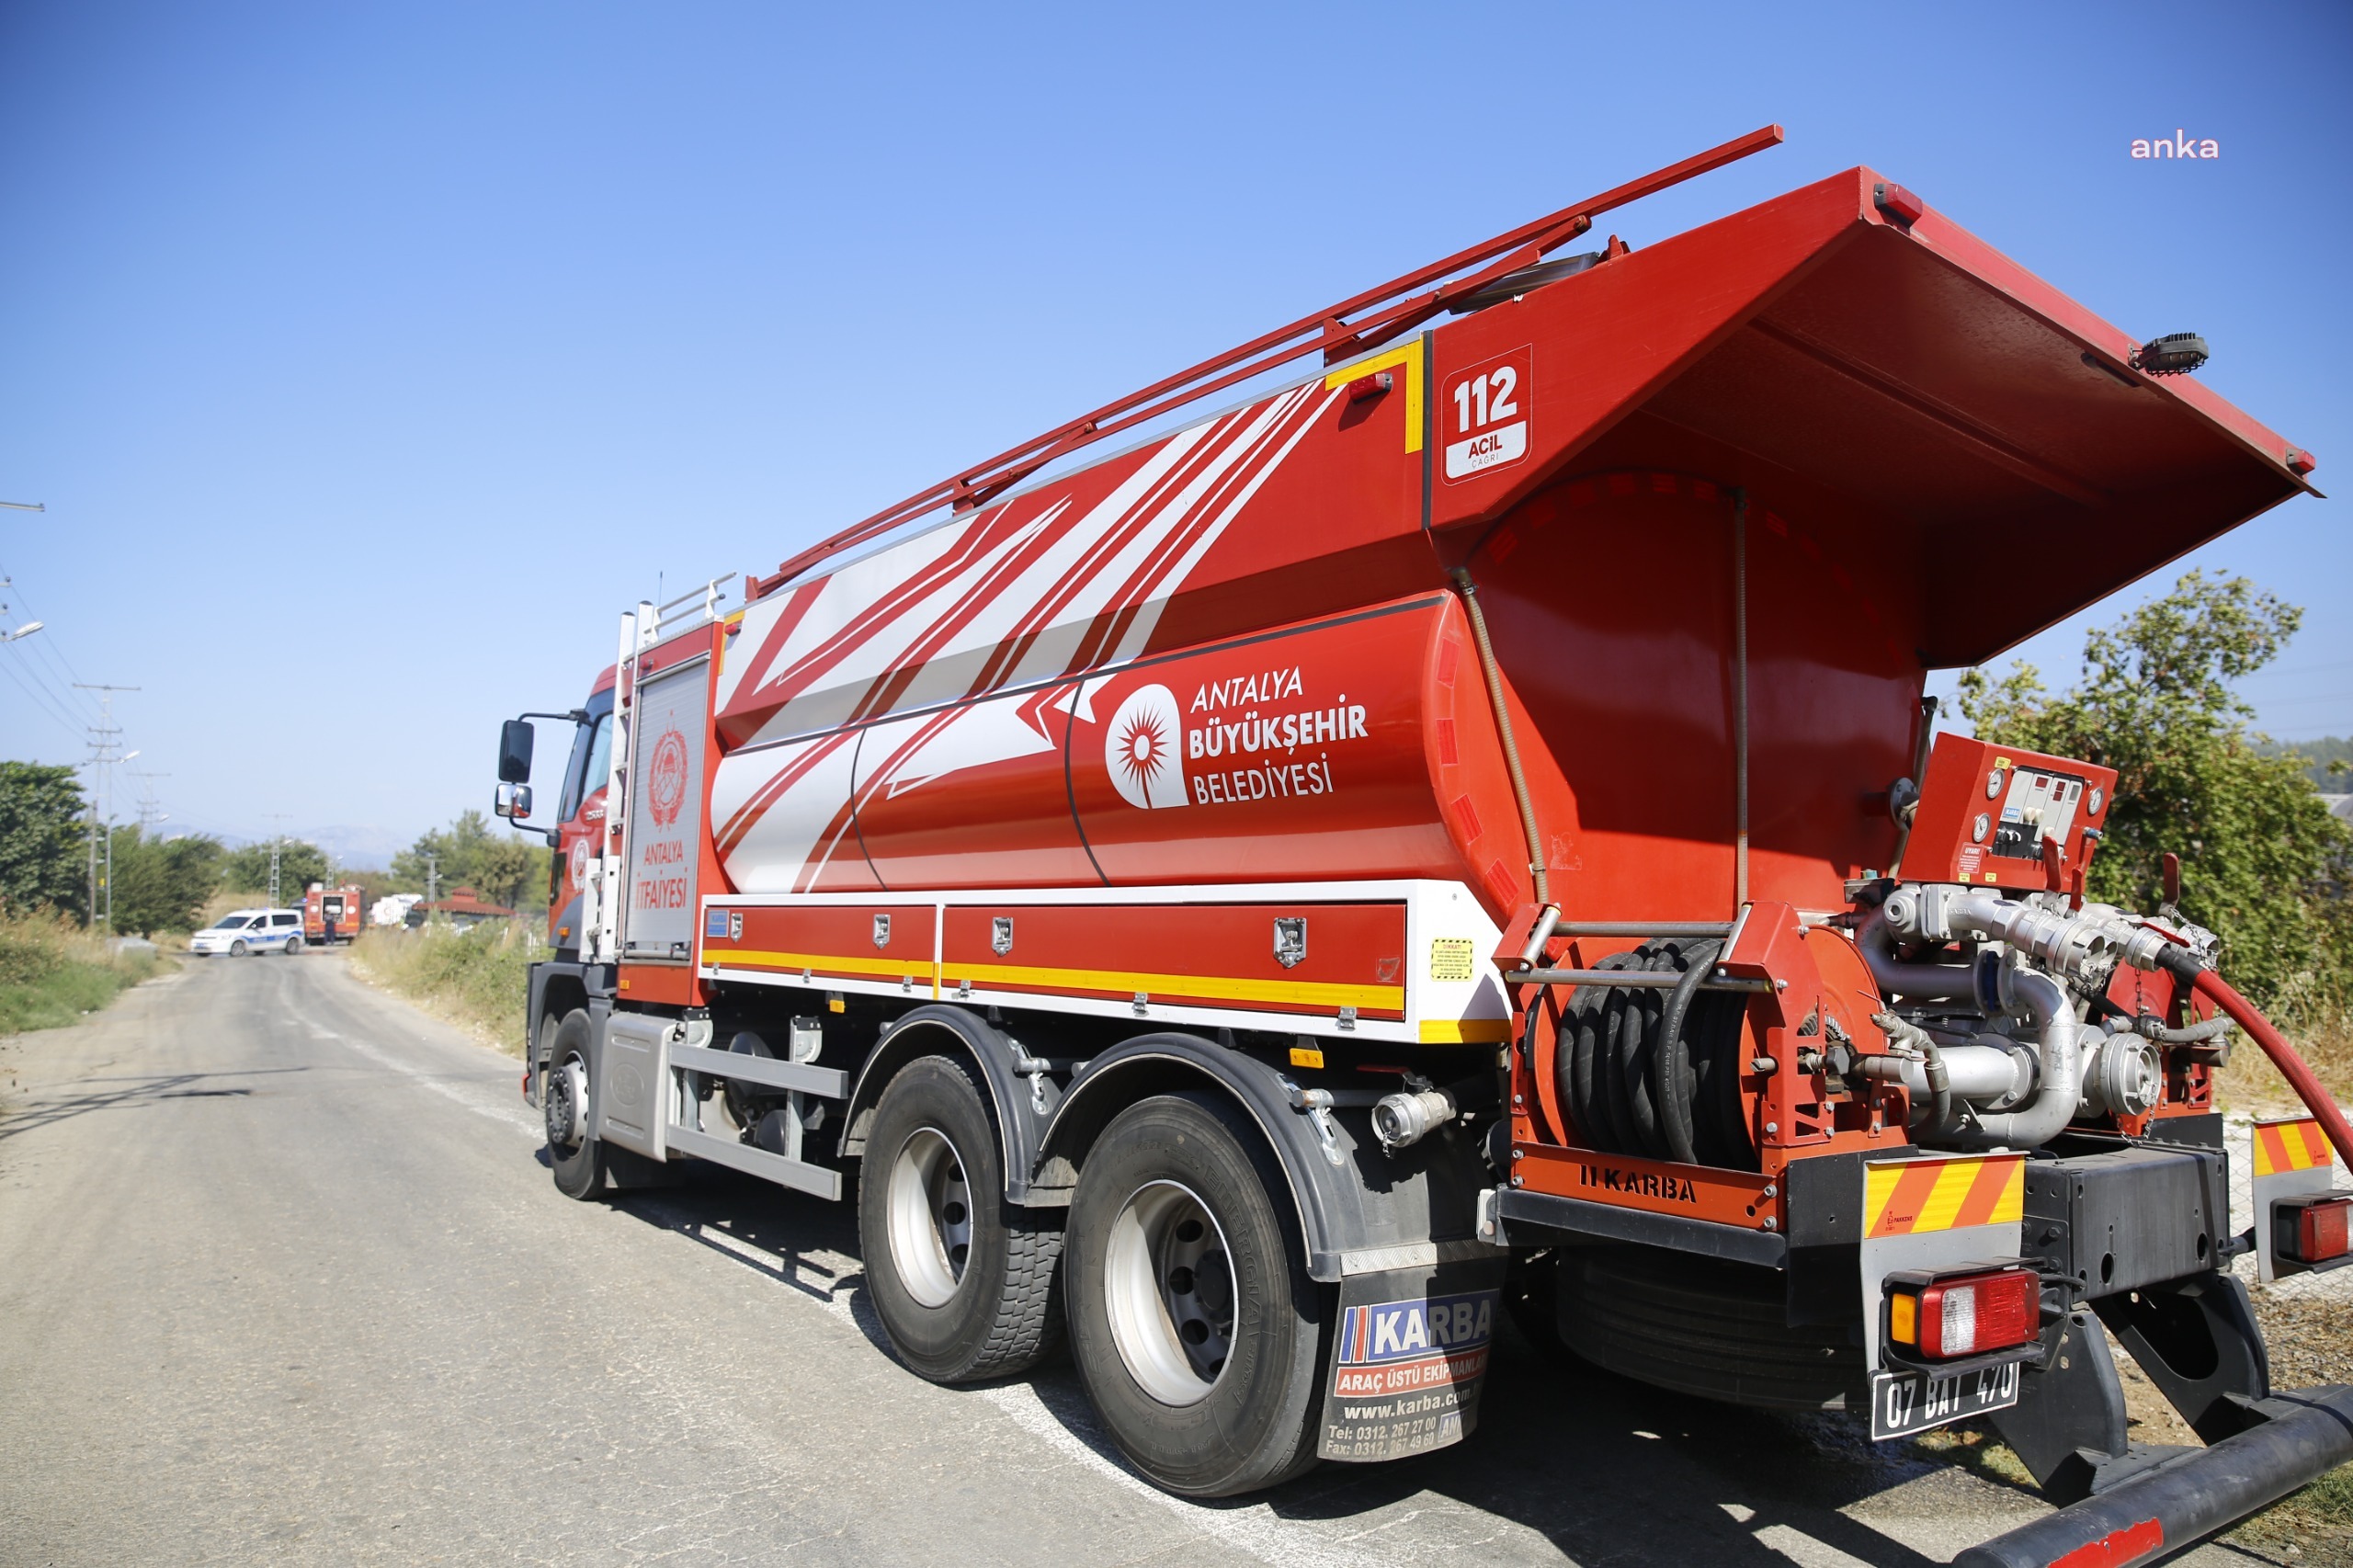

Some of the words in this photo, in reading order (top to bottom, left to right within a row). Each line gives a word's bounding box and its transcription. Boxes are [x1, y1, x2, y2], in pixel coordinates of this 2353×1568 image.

[1454, 366, 1517, 433] 112
[1469, 434, 1503, 459] ACİL
[1190, 665, 1303, 713] ANTALYA
[1189, 694, 1369, 759] BÜYÜKŞEHİR
[1194, 752, 1334, 804] BELEDİYESİ
[643, 839, 684, 866] ANTALYA
[635, 867, 688, 910] İTFAİYESİ
[1604, 1168, 1697, 1204] KARBA
[1374, 1300, 1492, 1354] KARBA
[1339, 1374, 1382, 1393] ARAÇ
[1387, 1365, 1420, 1388] ÜSTÜ
[1886, 1379, 1916, 1428] 07
[1325, 1439, 1351, 1455] Fax:
[1354, 1441, 1386, 1456] 0312.
[1390, 1437, 1408, 1453] 267
[1410, 1435, 1421, 1449] 49
[1423, 1432, 1434, 1446] 60
[1328, 1425, 1353, 1440] Tel:
[1357, 1426, 1388, 1440] 0312.
[1392, 1421, 1410, 1437] 267
[1412, 1419, 1424, 1434] 27
[1425, 1416, 1437, 1431] 00
